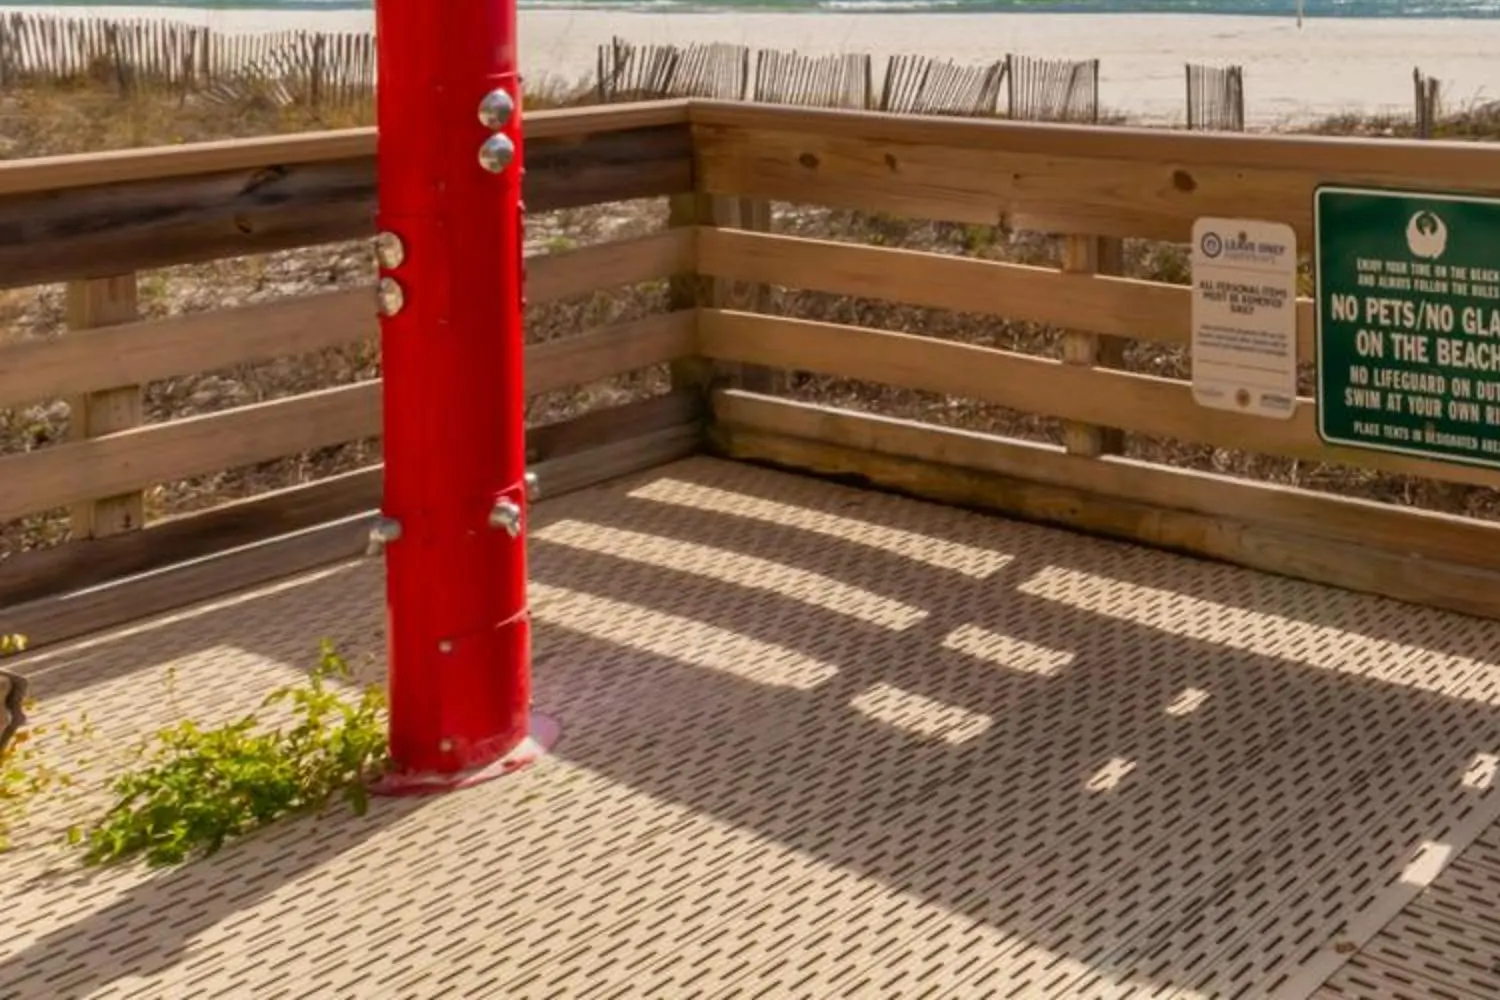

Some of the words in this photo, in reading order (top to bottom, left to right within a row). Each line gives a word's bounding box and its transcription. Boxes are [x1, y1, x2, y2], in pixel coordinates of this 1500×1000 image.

[1357, 257, 1382, 274] ENJOY
[1385, 259, 1408, 275] YOUR
[1411, 261, 1431, 278] TIME
[1434, 264, 1447, 278] ON
[1450, 265, 1467, 280] THE
[1470, 267, 1500, 282] BEACH
[1357, 273, 1375, 287] AND
[1378, 274, 1411, 290] ALWAYS
[1414, 277, 1448, 294] FOLLOW
[1451, 281, 1468, 296] THE
[1471, 283, 1500, 299] RULES
[1331, 293, 1358, 321] NO
[1365, 297, 1454, 332] PETS/NO
[1356, 330, 1384, 358] ON
[1390, 333, 1429, 363] THE
[1349, 365, 1369, 385] NO
[1373, 367, 1446, 394] LIFEGUARD
[1451, 377, 1471, 397] ON
[1344, 387, 1381, 410] SWIM
[1387, 392, 1403, 413] AT
[1407, 394, 1442, 419] YOUR
[1448, 400, 1480, 423] OWN
[1353, 421, 1380, 436] PLACE
[1383, 424, 1409, 441] TENTS
[1412, 428, 1422, 442] IN
[1425, 429, 1479, 451] DESIGNATED
